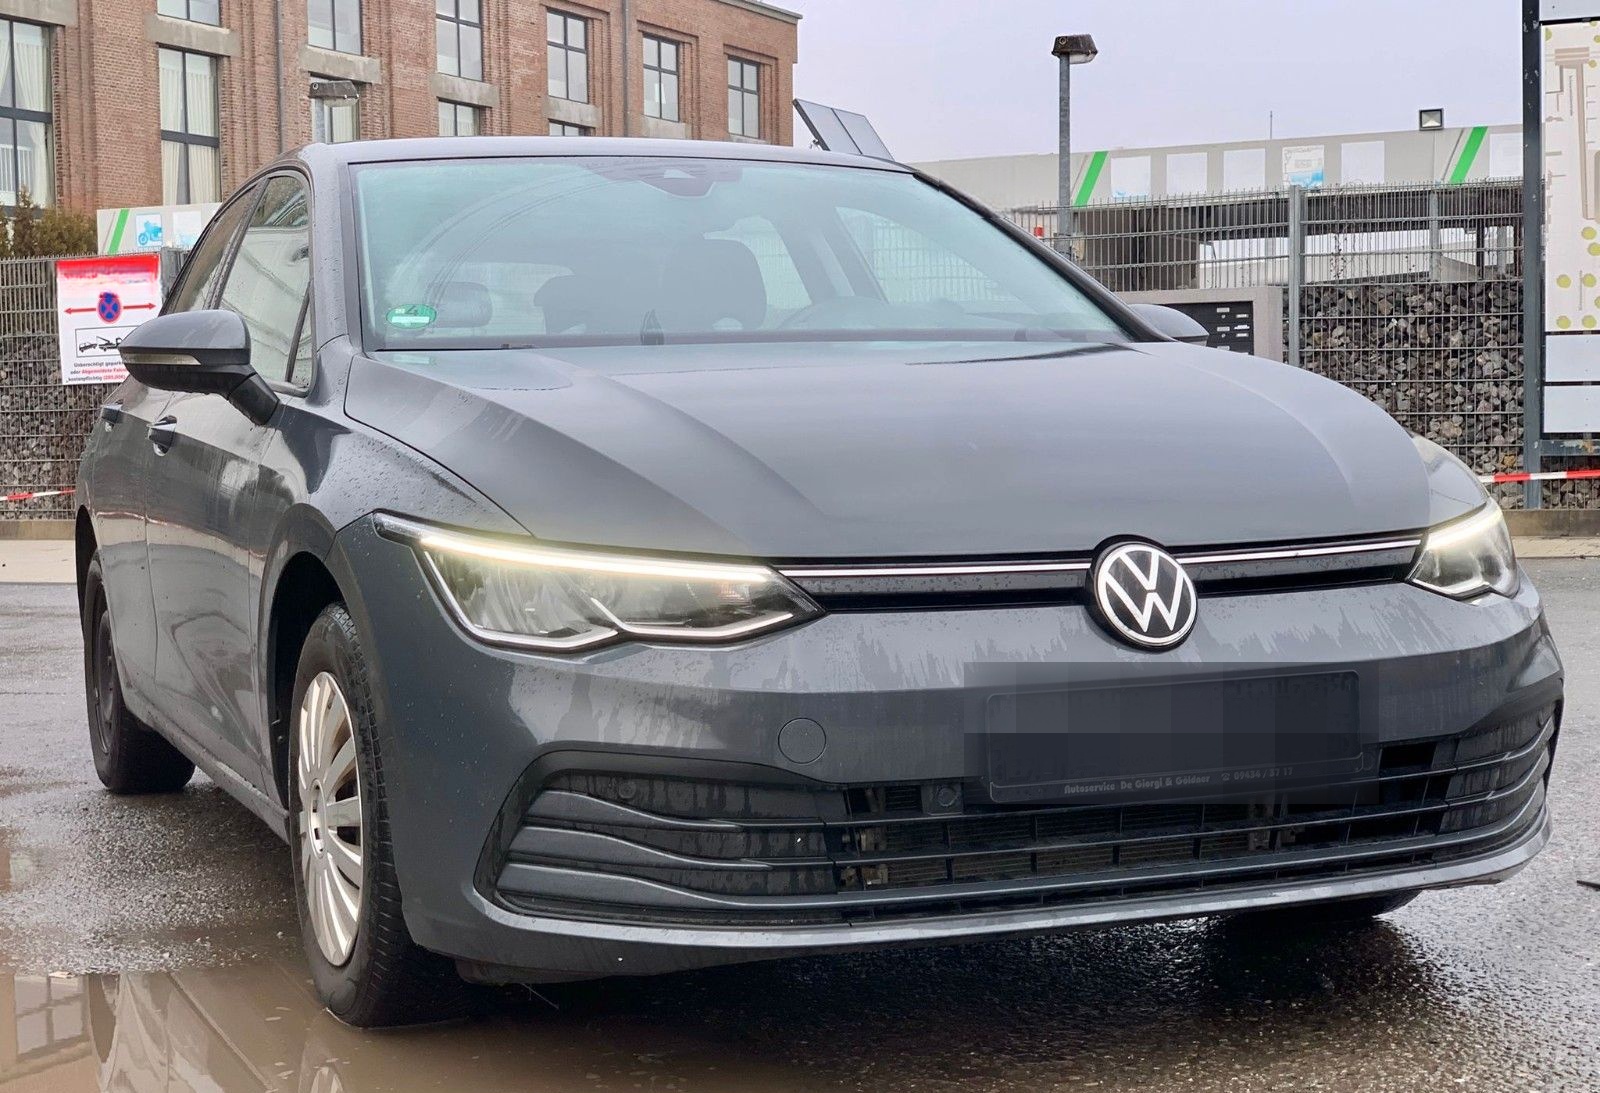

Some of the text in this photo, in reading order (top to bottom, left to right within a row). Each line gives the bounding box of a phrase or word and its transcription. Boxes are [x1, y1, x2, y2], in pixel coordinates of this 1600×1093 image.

[1098, 545, 1196, 644] VW
[1064, 781, 1116, 794] Autoservice
[1120, 780, 1133, 790] De
[1135, 777, 1163, 790] Giorgi
[1165, 777, 1173, 786] &
[1175, 774, 1210, 785] Göldner
